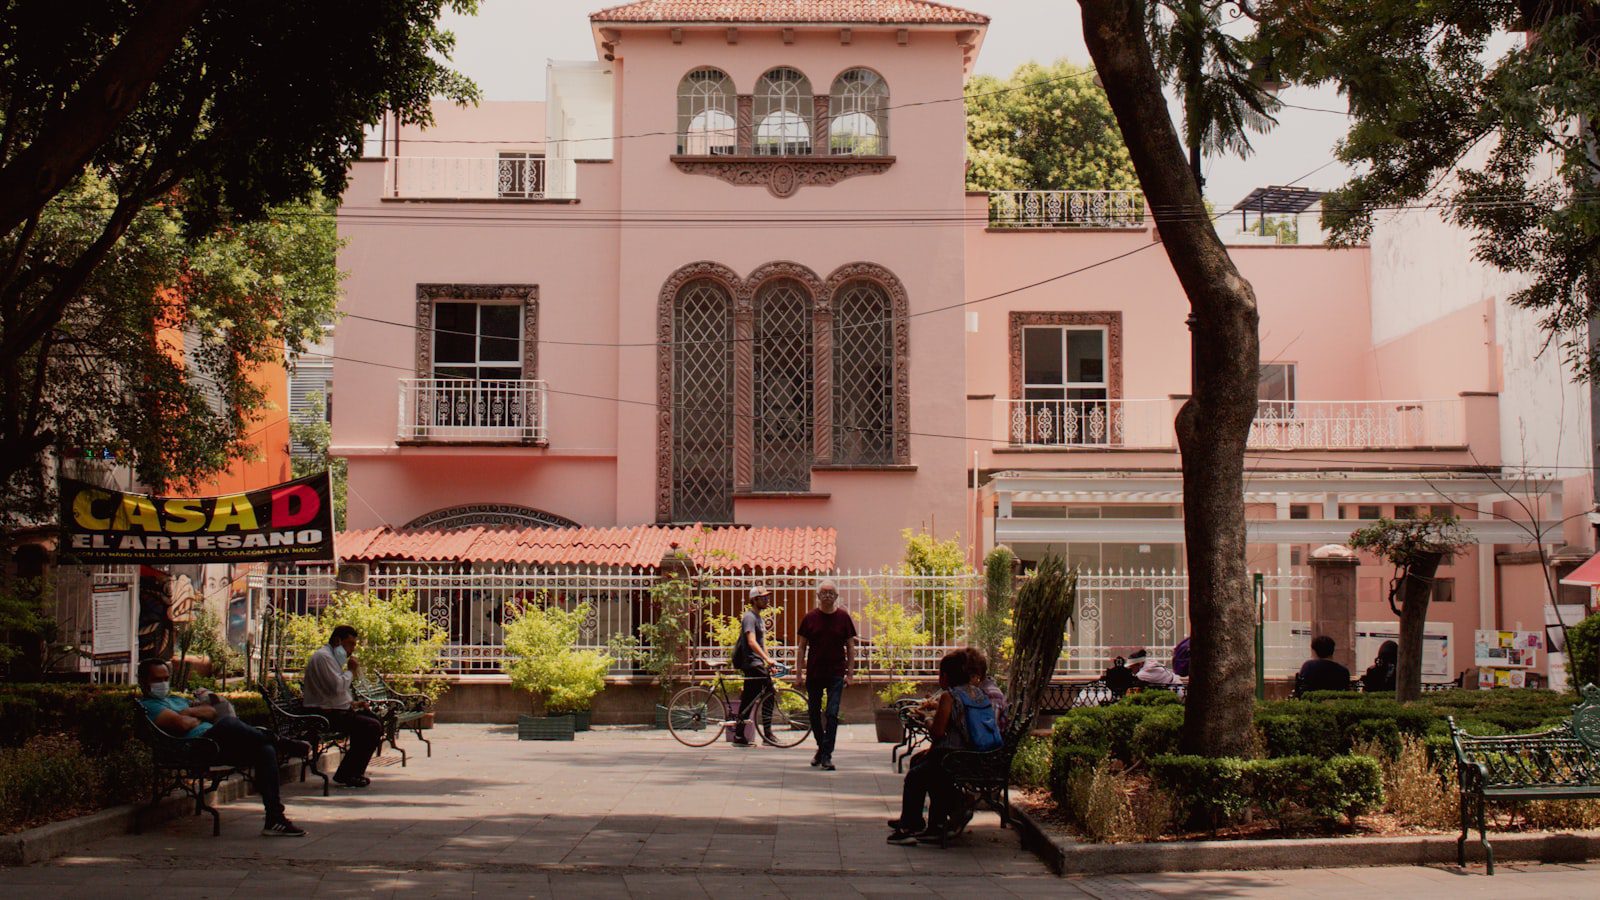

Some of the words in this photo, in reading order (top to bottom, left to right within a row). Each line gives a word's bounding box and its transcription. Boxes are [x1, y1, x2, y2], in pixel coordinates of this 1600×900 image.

[72, 489, 259, 533] CASA
[271, 484, 320, 529] D
[72, 534, 110, 548] EL
[119, 529, 322, 549] ARTESANO
